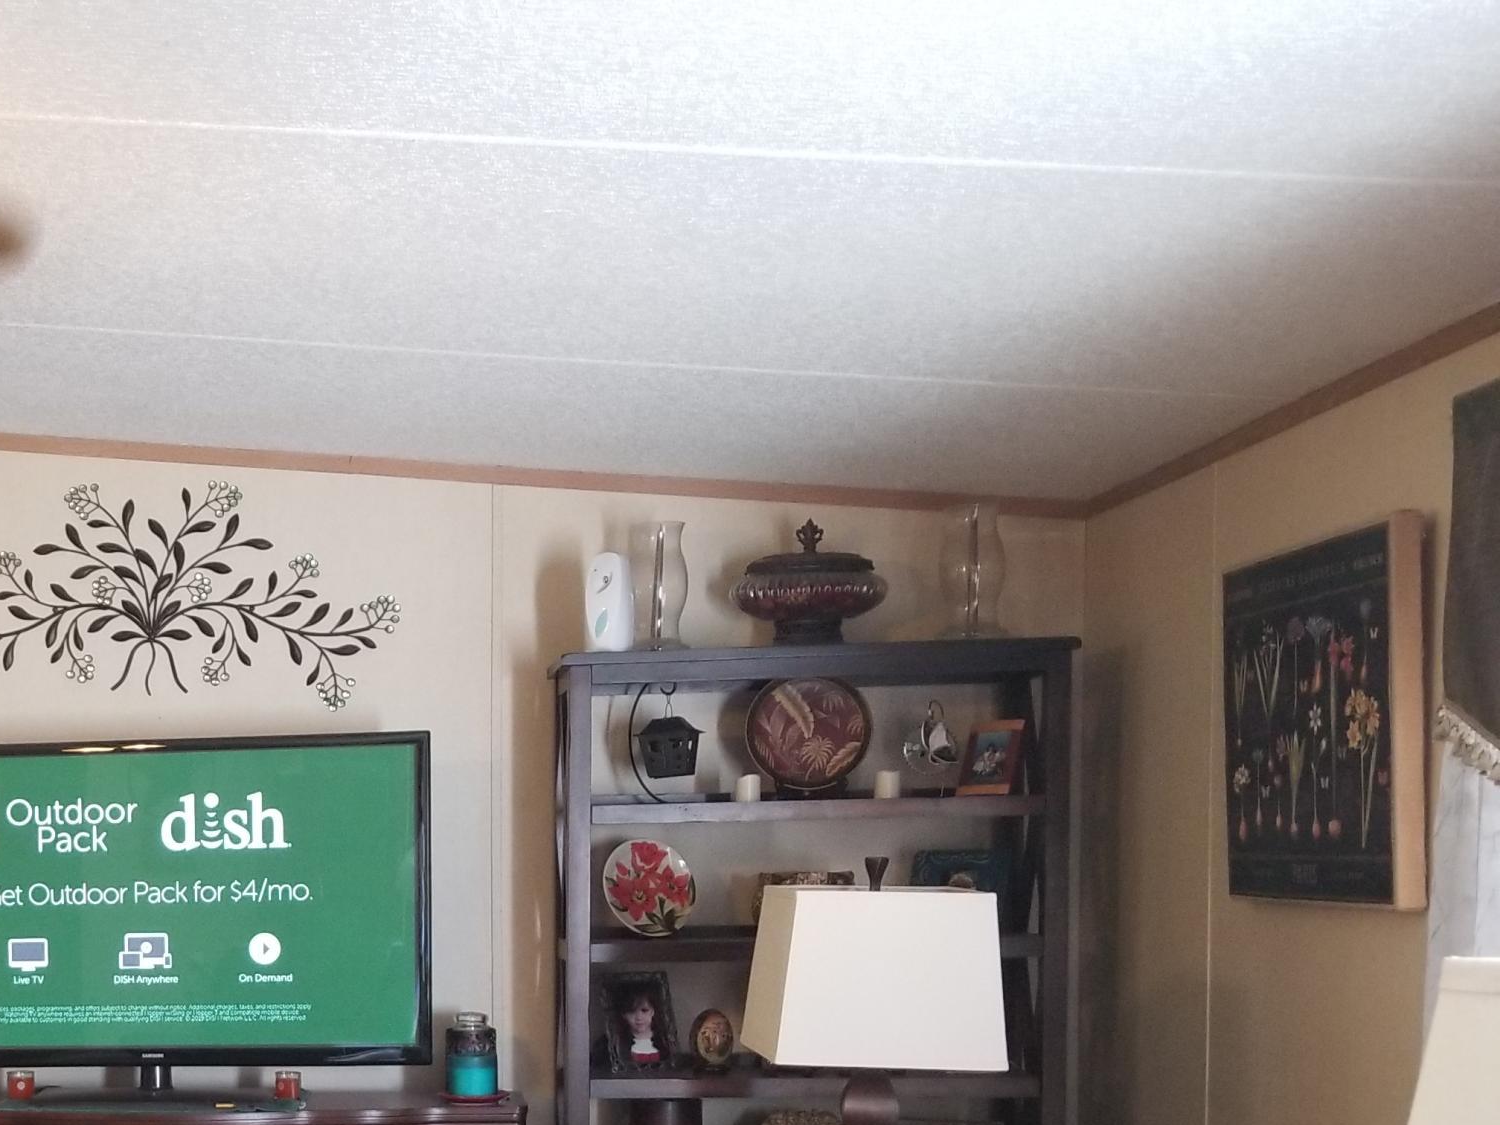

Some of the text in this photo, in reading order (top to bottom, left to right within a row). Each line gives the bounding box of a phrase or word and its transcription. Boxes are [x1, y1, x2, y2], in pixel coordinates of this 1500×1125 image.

[6, 797, 138, 826] Outdoor
[160, 791, 290, 851] dish
[37, 825, 108, 852] Pack
[28, 882, 129, 906] Outdoor
[134, 880, 188, 904] Pack
[192, 879, 226, 903] for
[230, 877, 314, 902] $4/mo.
[13, 975, 45, 985] Live TV
[113, 974, 179, 986] DISH Anywhere
[238, 973, 293, 983] On Demand
